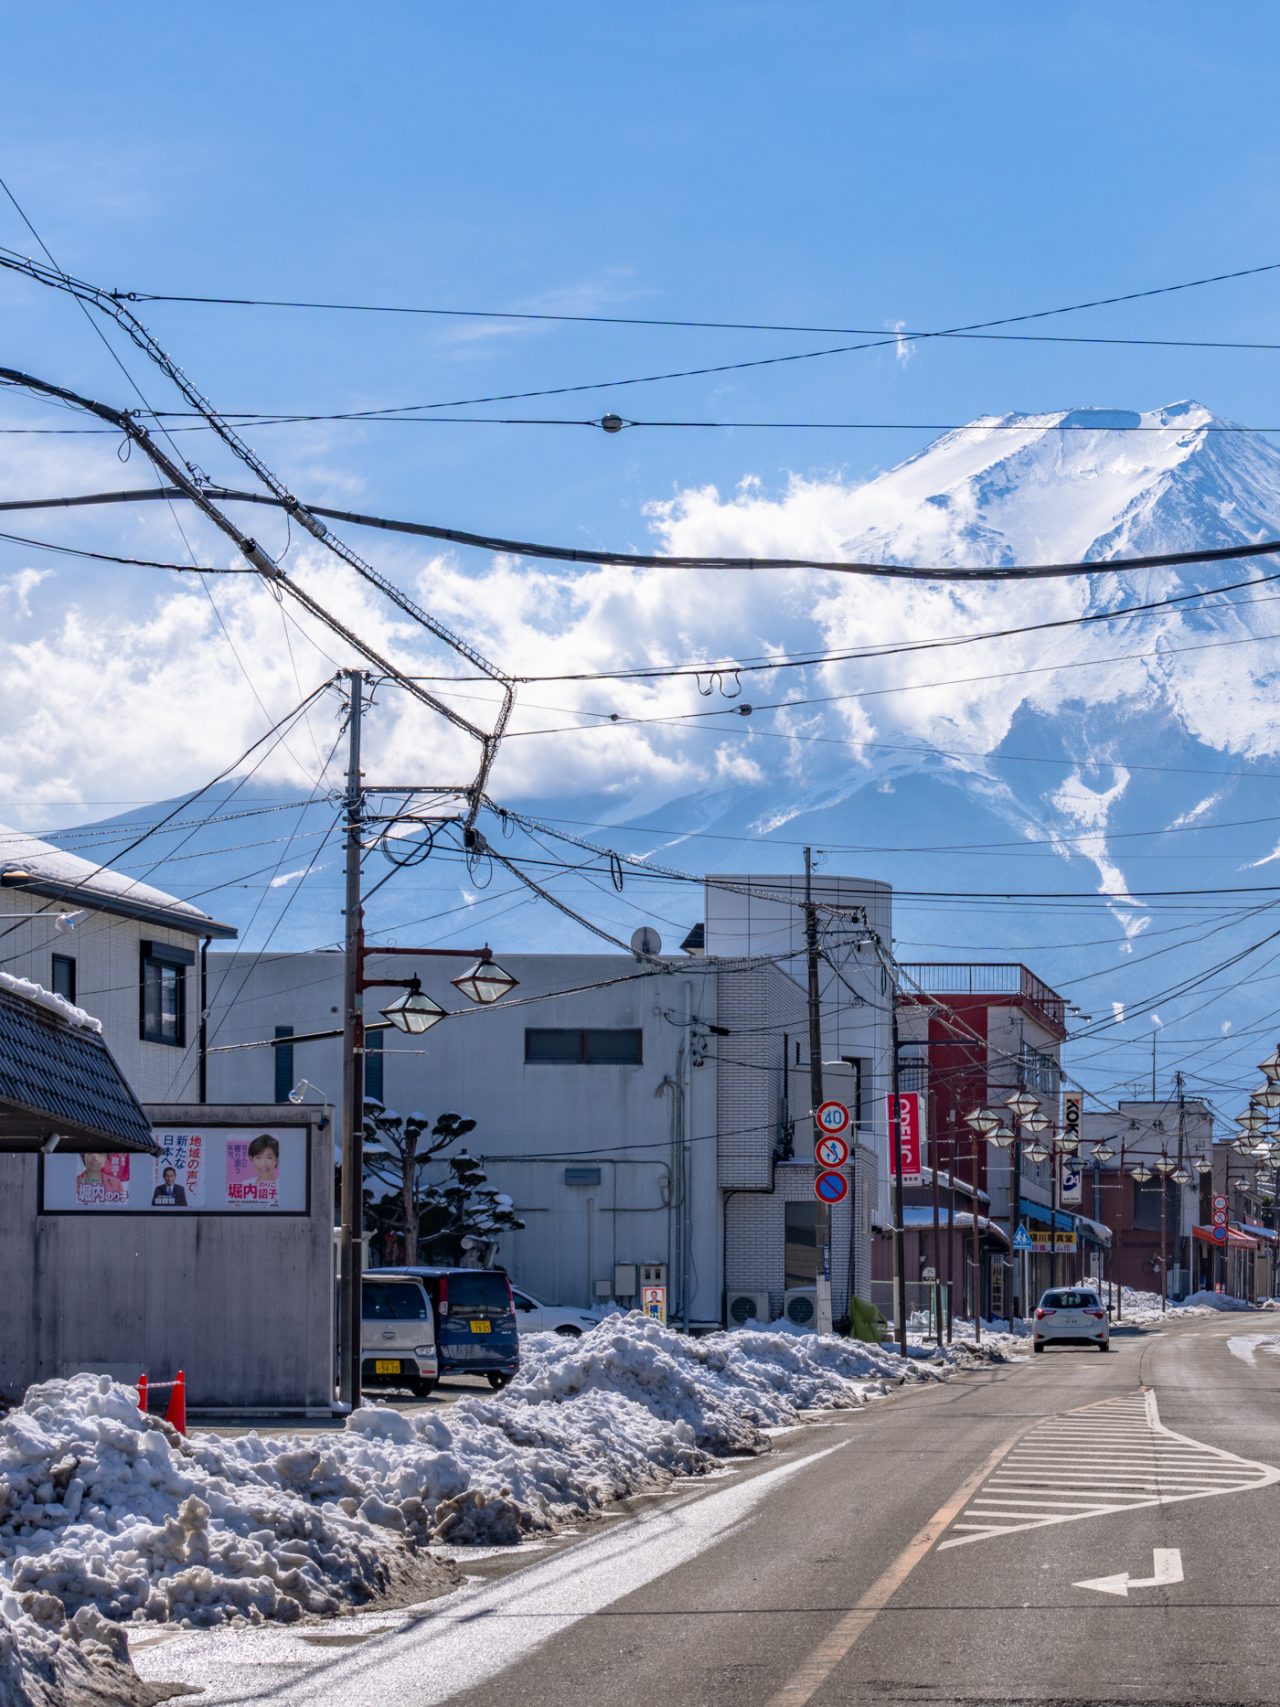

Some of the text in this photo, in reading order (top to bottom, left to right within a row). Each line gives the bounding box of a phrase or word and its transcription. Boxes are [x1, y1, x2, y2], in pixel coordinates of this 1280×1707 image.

[824, 1110, 842, 1125] 40
[161, 1135, 174, 1166] 日本へ
[174, 1135, 188, 1169] 新たな
[79, 1184, 128, 1202] 堀内のり子
